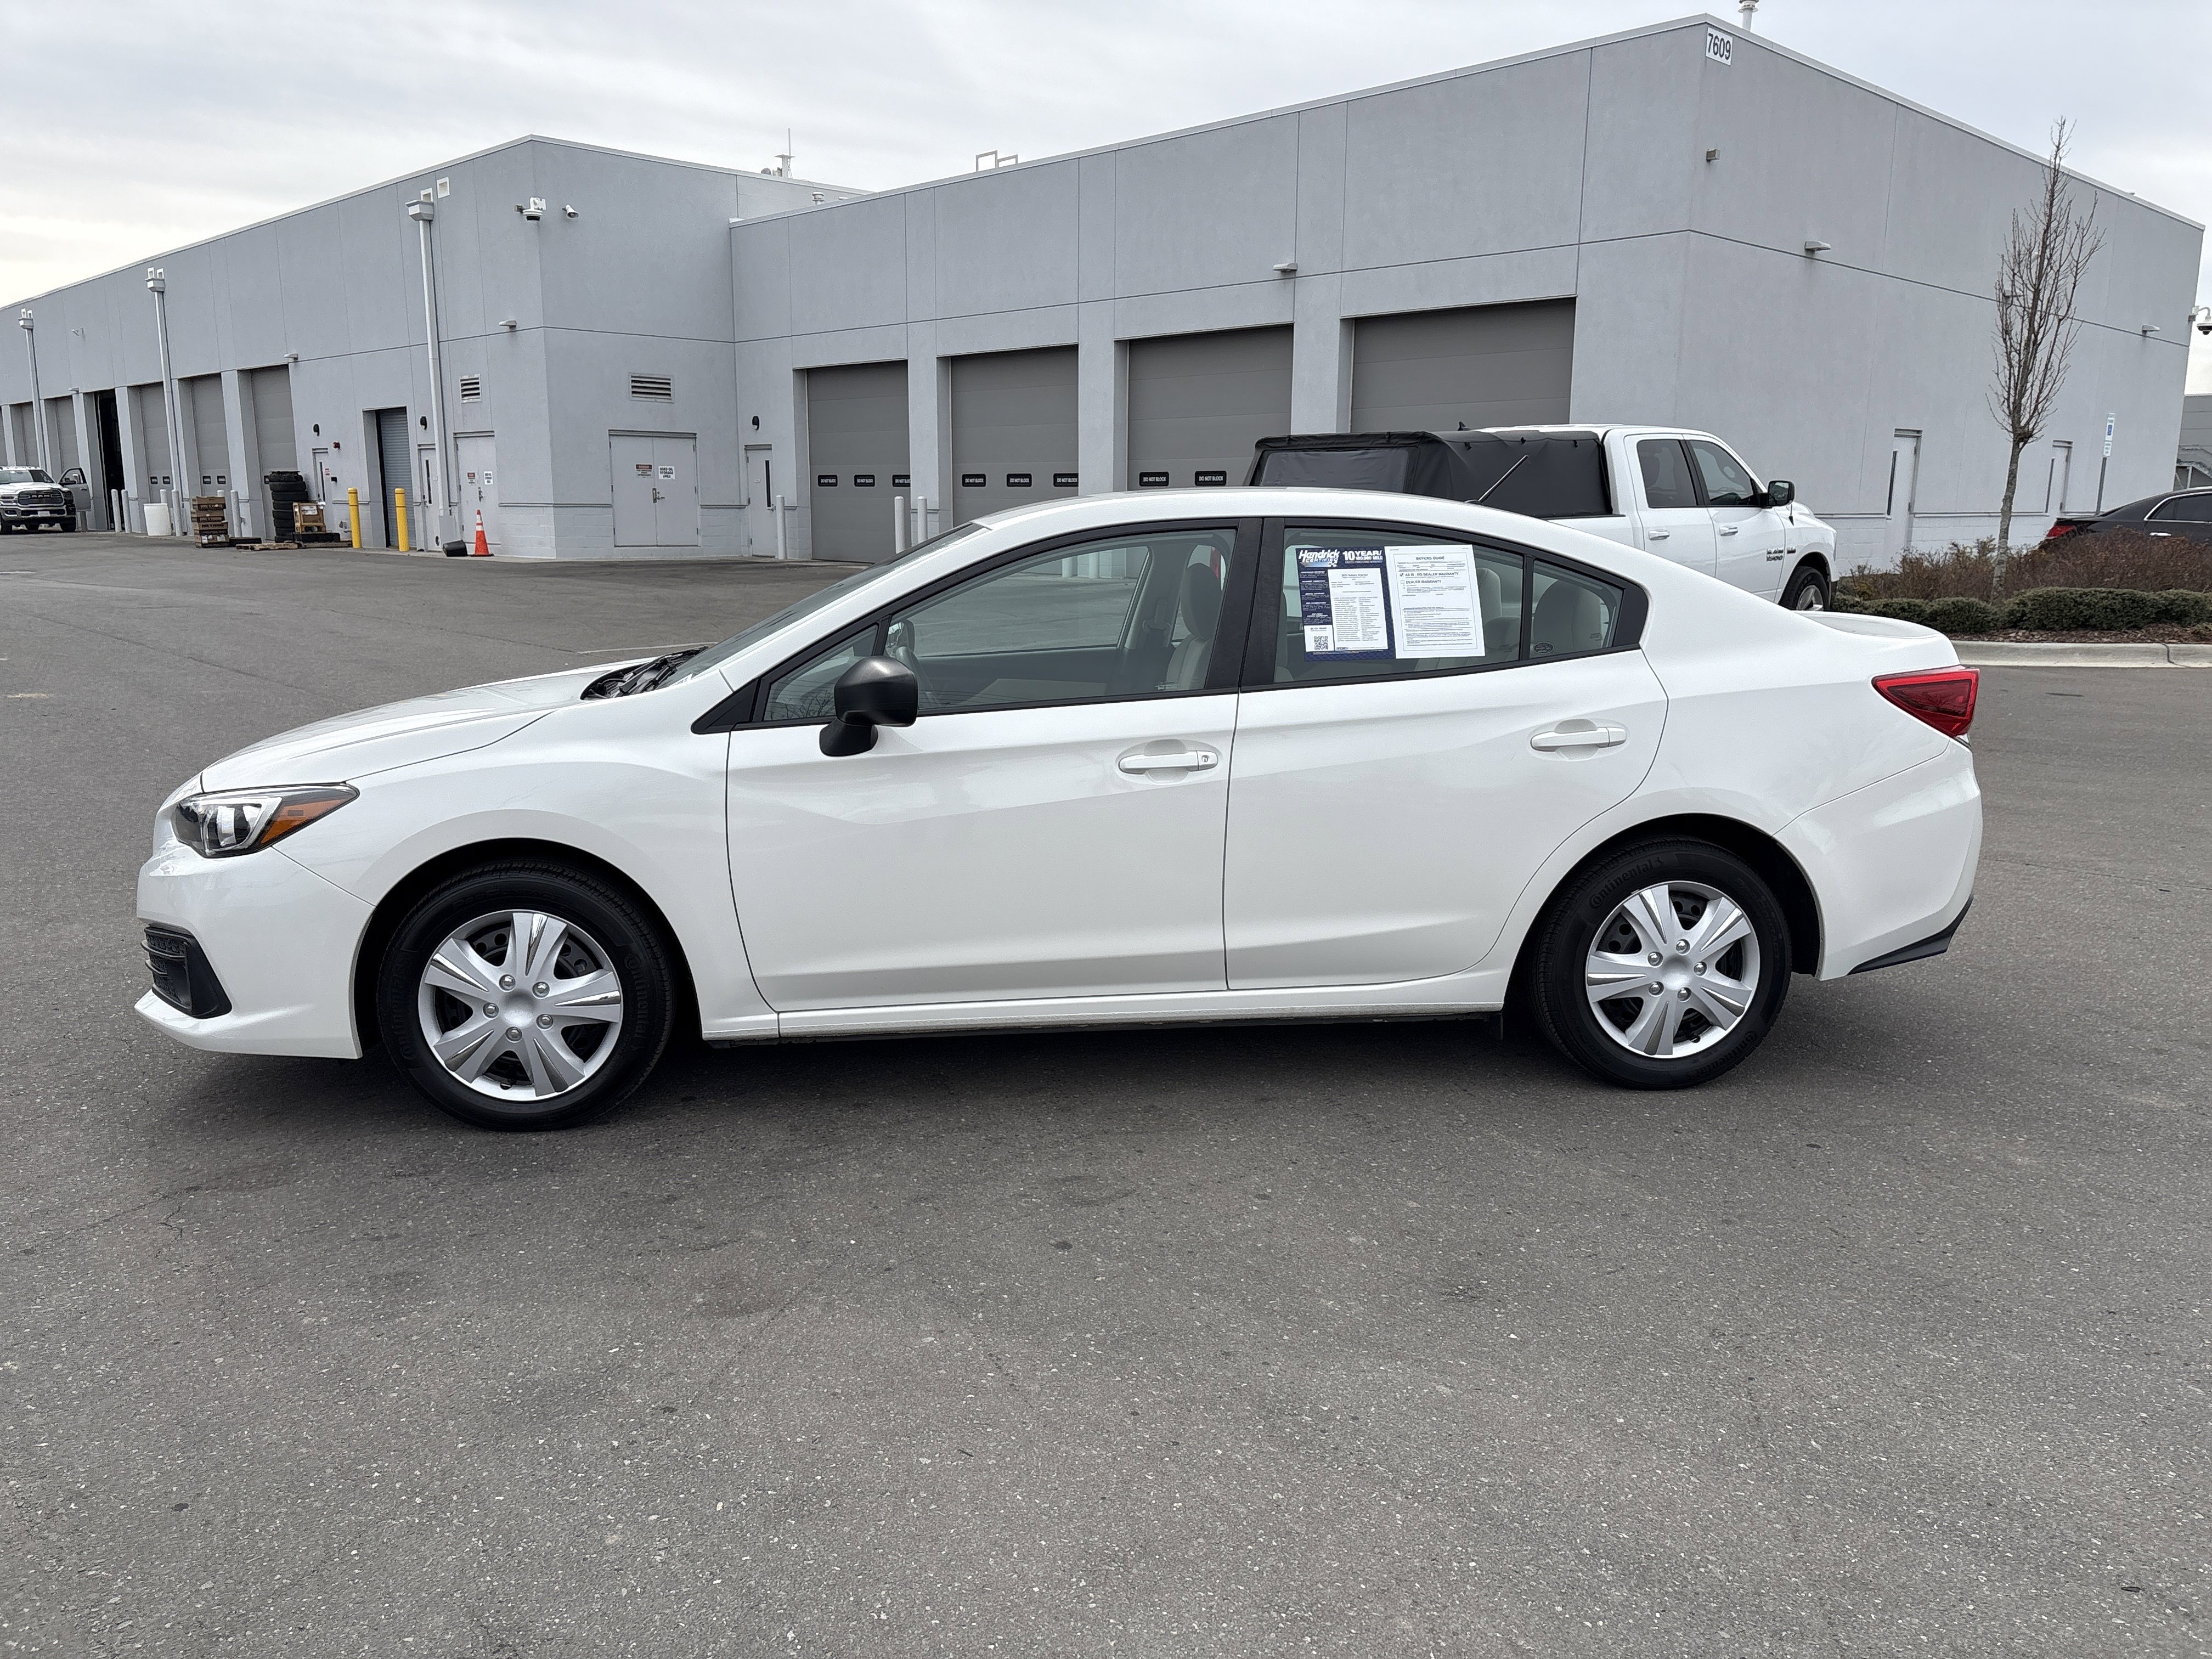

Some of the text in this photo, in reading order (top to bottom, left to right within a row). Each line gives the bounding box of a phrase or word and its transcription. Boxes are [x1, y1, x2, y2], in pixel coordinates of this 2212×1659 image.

[1708, 33, 1731, 60] 7609
[1298, 549, 1340, 562] Hendrick
[1342, 551, 1355, 561] 10
[1589, 859, 1654, 909] Continental
[624, 953, 650, 1039] Continental
